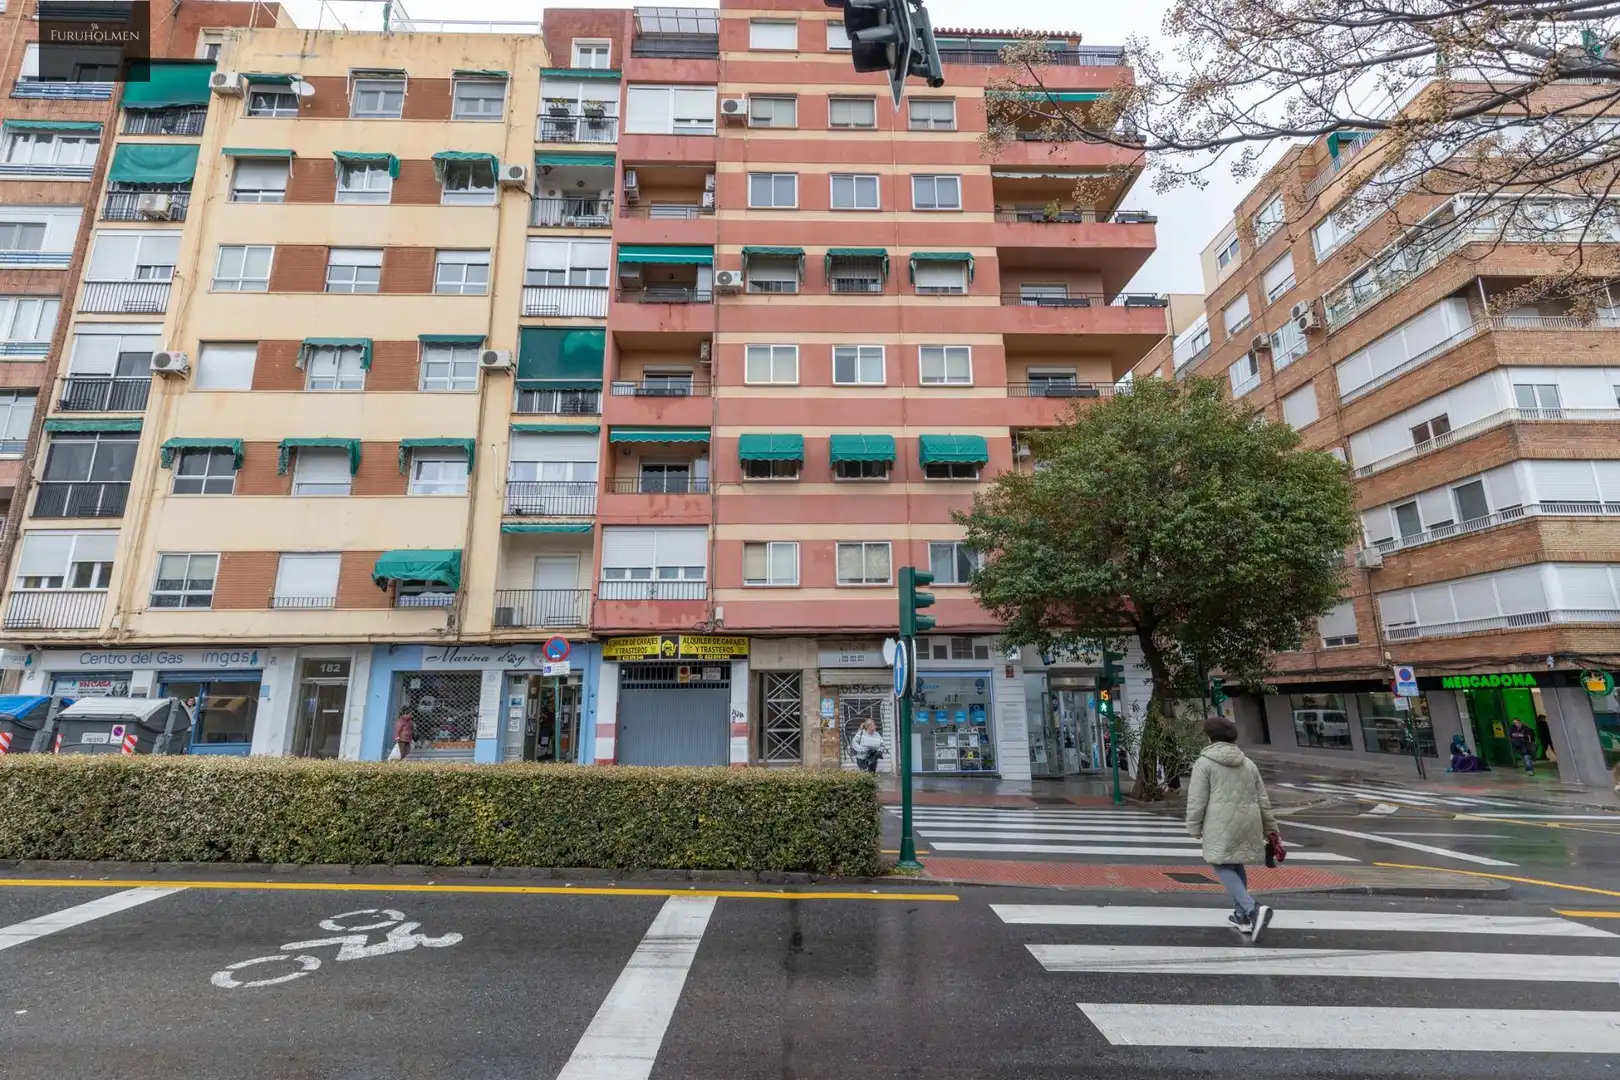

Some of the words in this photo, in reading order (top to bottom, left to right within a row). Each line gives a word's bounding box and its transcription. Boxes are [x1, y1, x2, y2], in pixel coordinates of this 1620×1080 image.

[682, 637, 711, 645] ALQUILER
[425, 645, 491, 664] Marina
[619, 646, 648, 655] TRASTEROS
[700, 646, 734, 654] TRASTEROS
[79, 652, 128, 665] Centro
[130, 651, 152, 664] del
[156, 651, 184, 664] Gas
[201, 651, 250, 667] imgas
[320, 663, 341, 673] 182
[79, 680, 91, 688] EN
[91, 680, 112, 688] CASA
[1442, 673, 1536, 689] MERCADONA
[1100, 689, 1109, 701] 15
